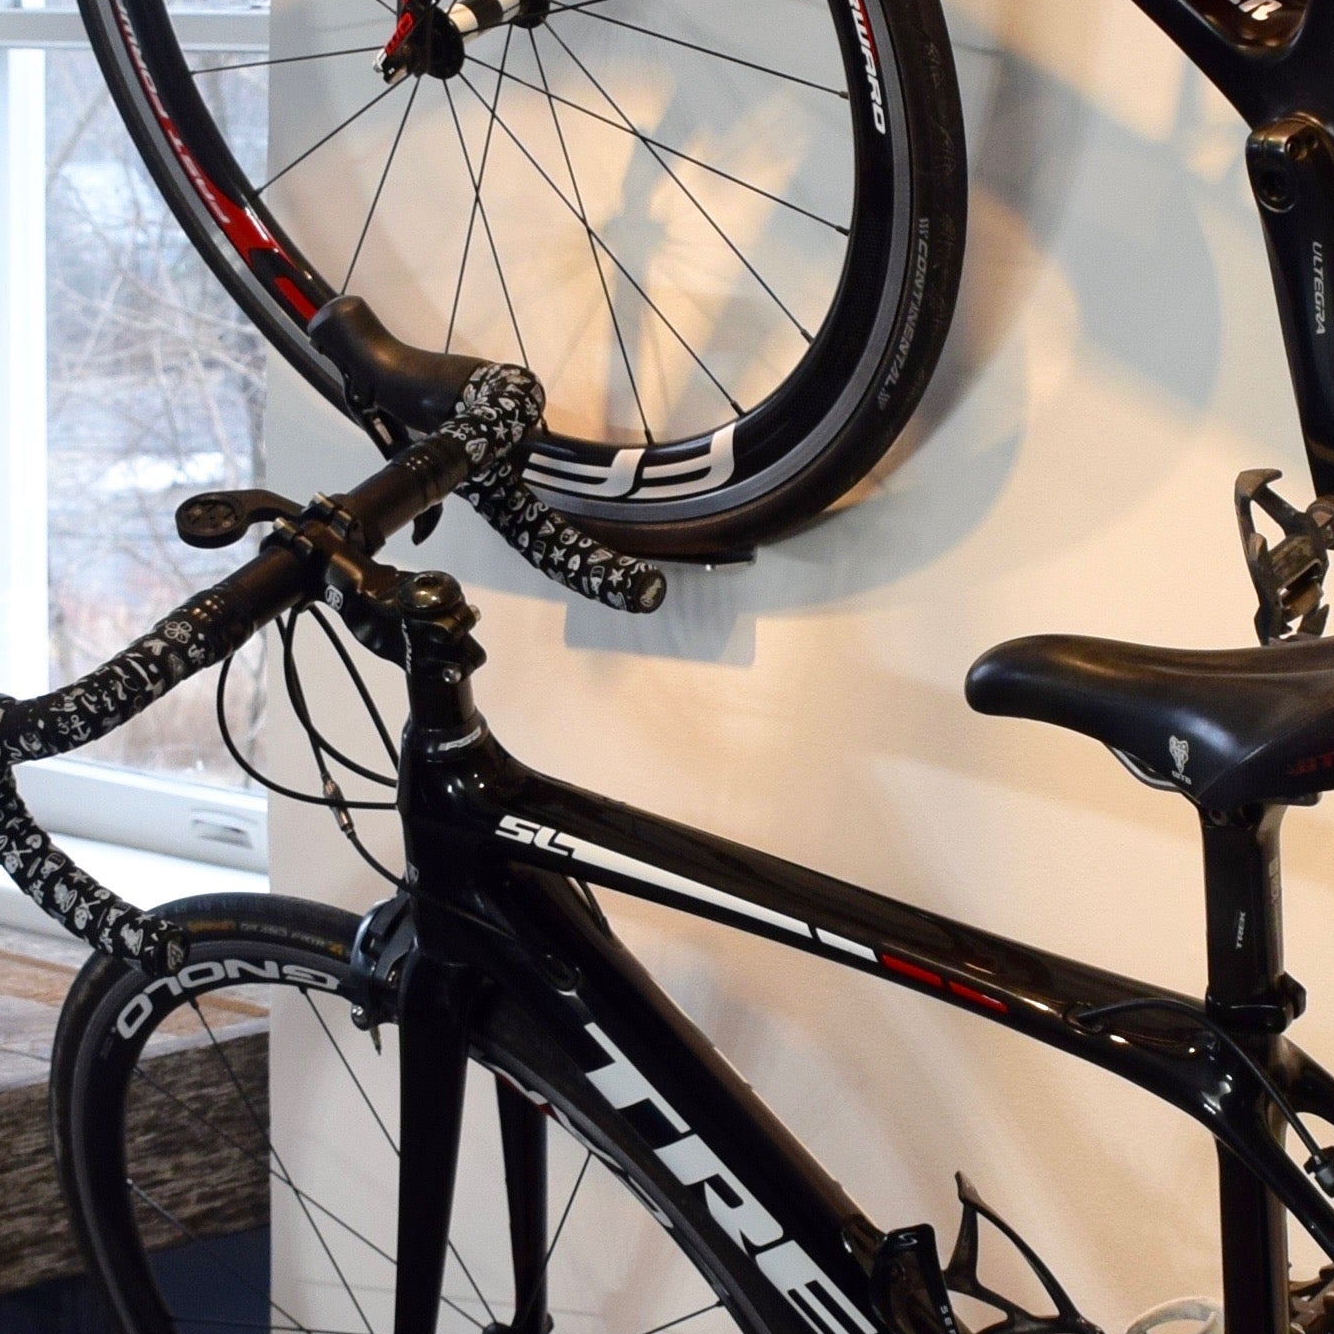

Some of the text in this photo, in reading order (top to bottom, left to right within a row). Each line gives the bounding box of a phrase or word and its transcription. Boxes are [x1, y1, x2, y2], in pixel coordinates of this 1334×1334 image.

[885, 238, 930, 396] CONTINENTAL
[1311, 240, 1327, 335] ULTEGRA
[1235, 910, 1246, 950] TREK
